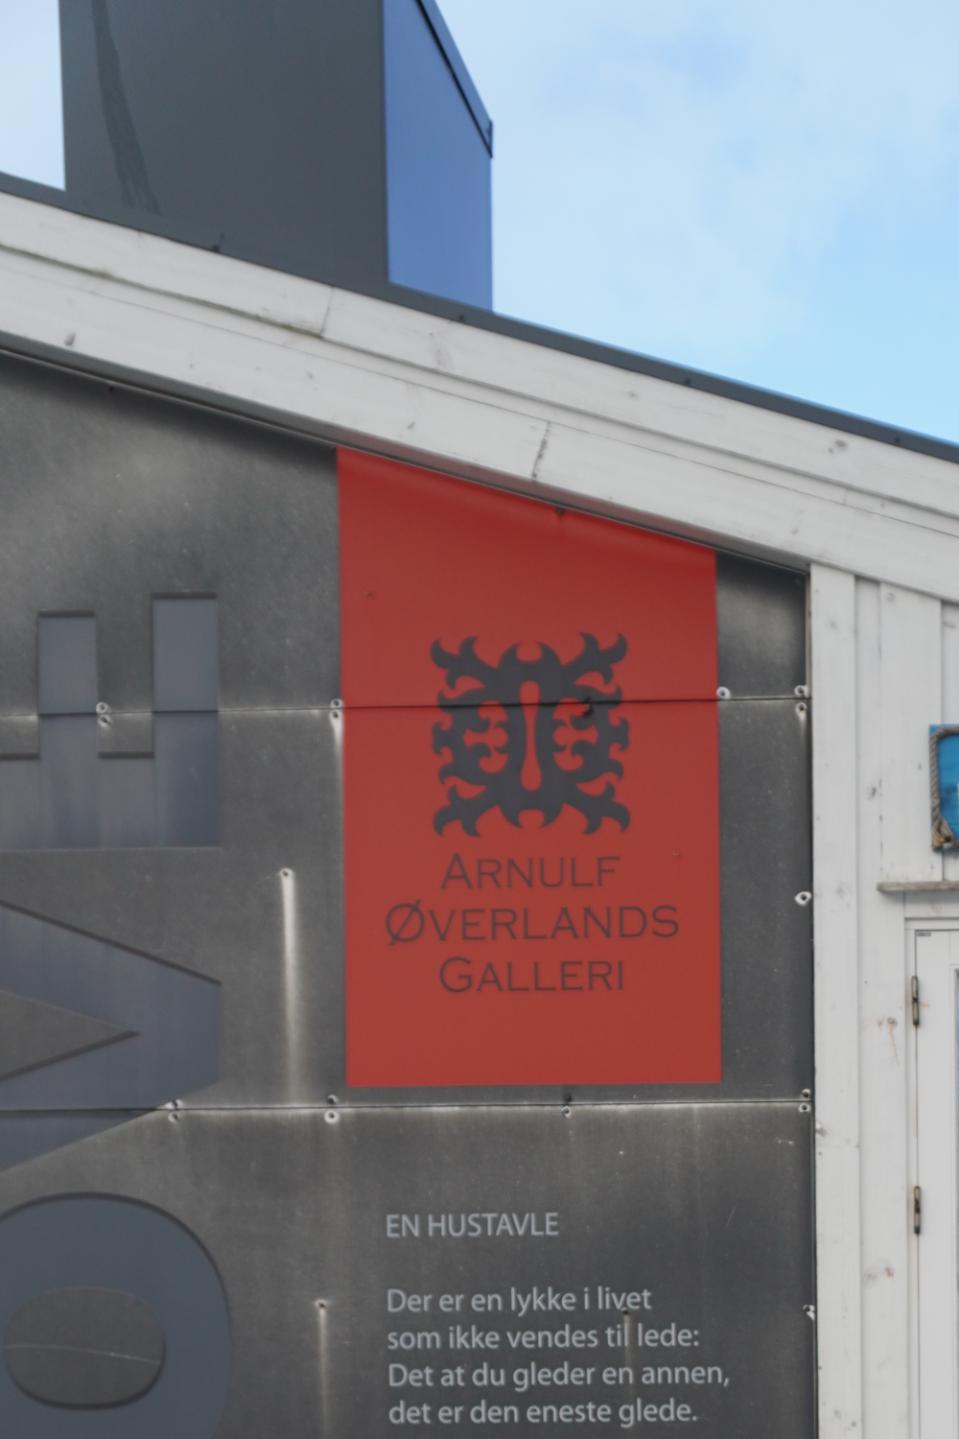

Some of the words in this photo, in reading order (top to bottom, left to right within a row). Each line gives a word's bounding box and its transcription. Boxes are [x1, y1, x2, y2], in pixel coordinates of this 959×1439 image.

[440, 853, 620, 889] ARNULF
[385, 900, 680, 946] ØVERLANDS
[439, 956, 624, 992] GALLERI
[386, 1214, 420, 1238] EN
[428, 1212, 559, 1237] HUSTAVLE
[387, 1288, 432, 1312] Der
[438, 1293, 465, 1312] er
[470, 1292, 503, 1312] en
[510, 1286, 576, 1317] lykke
[583, 1287, 590, 1309] i
[597, 1285, 652, 1310] livet
[387, 1331, 441, 1350] som
[449, 1325, 500, 1349] ikke
[506, 1323, 599, 1349] vendes
[605, 1323, 630, 1348] til
[637, 1322, 699, 1348] lede:
[388, 1363, 434, 1387] Det
[440, 1364, 465, 1387] at
[471, 1362, 505, 1387] du
[512, 1361, 596, 1393] gleder
[602, 1366, 634, 1385] en
[641, 1364, 730, 1388] annen,
[388, 1399, 431, 1425] det
[437, 1405, 464, 1424] er
[469, 1399, 519, 1424] den
[526, 1400, 612, 1423] eneste
[618, 1397, 698, 1429] glede.
